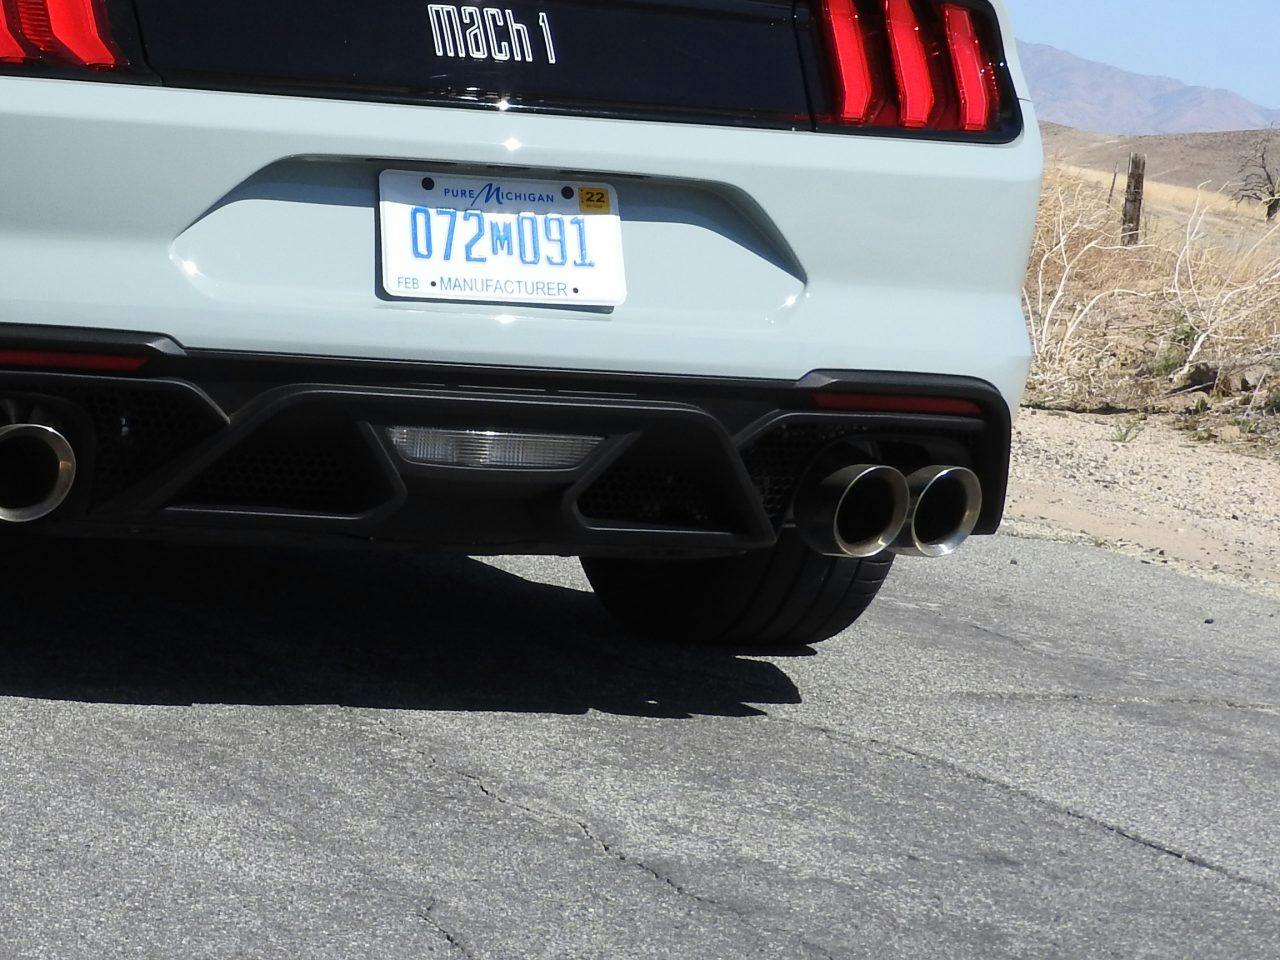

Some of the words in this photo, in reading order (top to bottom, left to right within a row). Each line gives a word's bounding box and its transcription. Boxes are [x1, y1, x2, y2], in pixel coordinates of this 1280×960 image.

[539, 12, 556, 64] 1
[444, 188, 474, 199] PURE
[471, 183, 555, 206] MICHIGAN
[585, 191, 605, 203] 22
[411, 206, 595, 267] 072M091
[397, 276, 420, 289] FEB
[440, 277, 567, 297] MANUFACTURER
